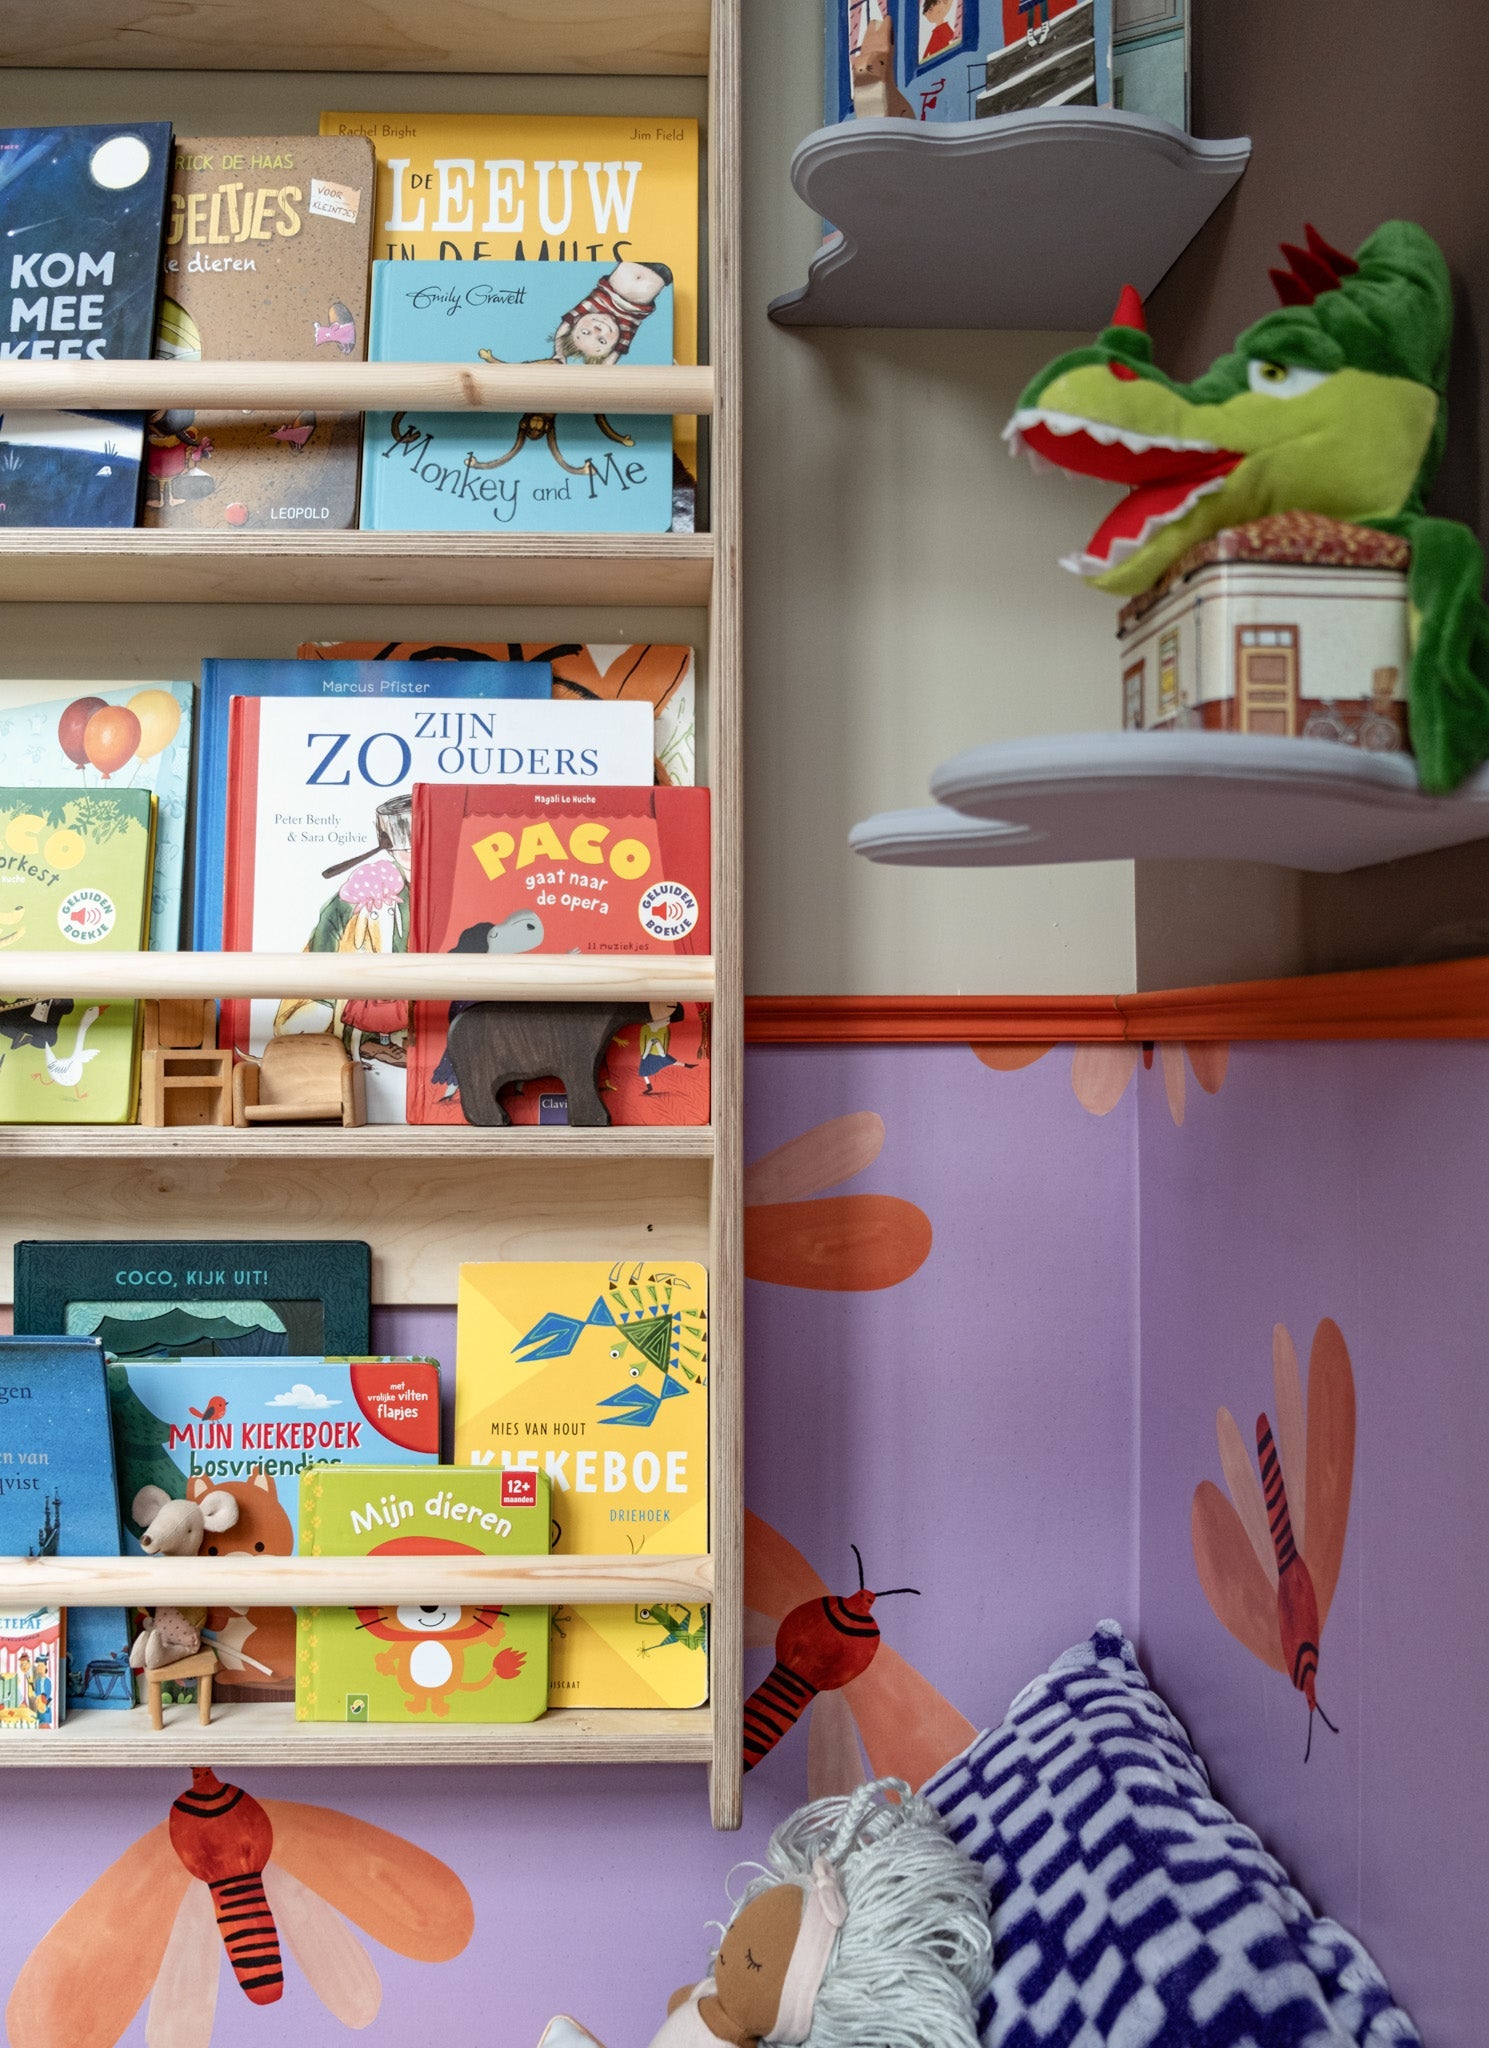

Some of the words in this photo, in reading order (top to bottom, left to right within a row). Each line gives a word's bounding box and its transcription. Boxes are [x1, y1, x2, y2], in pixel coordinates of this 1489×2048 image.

[338, 124, 377, 137] Rachel
[382, 125, 416, 137] Bright
[630, 129, 651, 141] Jim
[656, 129, 684, 141] Field
[175, 155, 213, 170] RICK
[222, 155, 244, 169] DE
[252, 154, 294, 169] HAAS
[411, 174, 433, 190] DE
[318, 186, 343, 200] VOOR
[384, 158, 643, 236] LEEUW
[10, 251, 115, 289] KOM
[188, 251, 256, 273] dieren
[406, 286, 462, 316] Emily
[465, 284, 527, 306] Gravett
[10, 294, 104, 332] MEE
[382, 424, 520, 522] Monkey
[533, 478, 571, 501] and
[588, 453, 648, 499] Me
[271, 507, 329, 520] LEOPOLD
[323, 680, 374, 693] Marcus
[381, 680, 430, 693] Pfister
[414, 712, 496, 748] ZIJN
[305, 732, 412, 787] ZO
[438, 747, 598, 776] OUDERS
[534, 794, 560, 806] Magali
[275, 813, 303, 825] Peter
[306, 814, 341, 828] Bently
[0, 814, 86, 870] CO
[287, 832, 297, 842] &
[301, 832, 325, 843] Sara
[328, 832, 368, 846] Ogilvie
[471, 821, 651, 881] PACO
[526, 869, 566, 890] gaat
[570, 873, 608, 891] naar
[62, 892, 113, 914] GELUIDEN
[537, 890, 557, 906] de
[561, 893, 609, 915] opera
[642, 885, 695, 909] GELUIDEN
[64, 923, 109, 940] BOEKJE
[645, 918, 692, 936] BOEKJE
[600, 941, 649, 952] muziekjes
[115, 1270, 178, 1288] COCO,
[187, 1270, 225, 1285] KIJK
[234, 1270, 268, 1285] UIT!
[390, 1382, 405, 1391] met
[367, 1393, 396, 1403] vrolijke
[398, 1389, 428, 1401] vilten
[377, 1405, 418, 1420] flapjes
[169, 1423, 233, 1450] MIJN
[241, 1421, 362, 1449] KIEKEBOEK
[491, 1423, 519, 1436] MIES
[525, 1423, 547, 1436] VAN
[553, 1423, 586, 1436] HOUT
[18, 1453, 50, 1465] van
[190, 1451, 342, 1477] bosvriend
[507, 1480, 530, 1494] 12+
[350, 1495, 414, 1535] Mijn
[425, 1491, 512, 1538] dieren
[610, 1509, 671, 1522] DRIEHOEK
